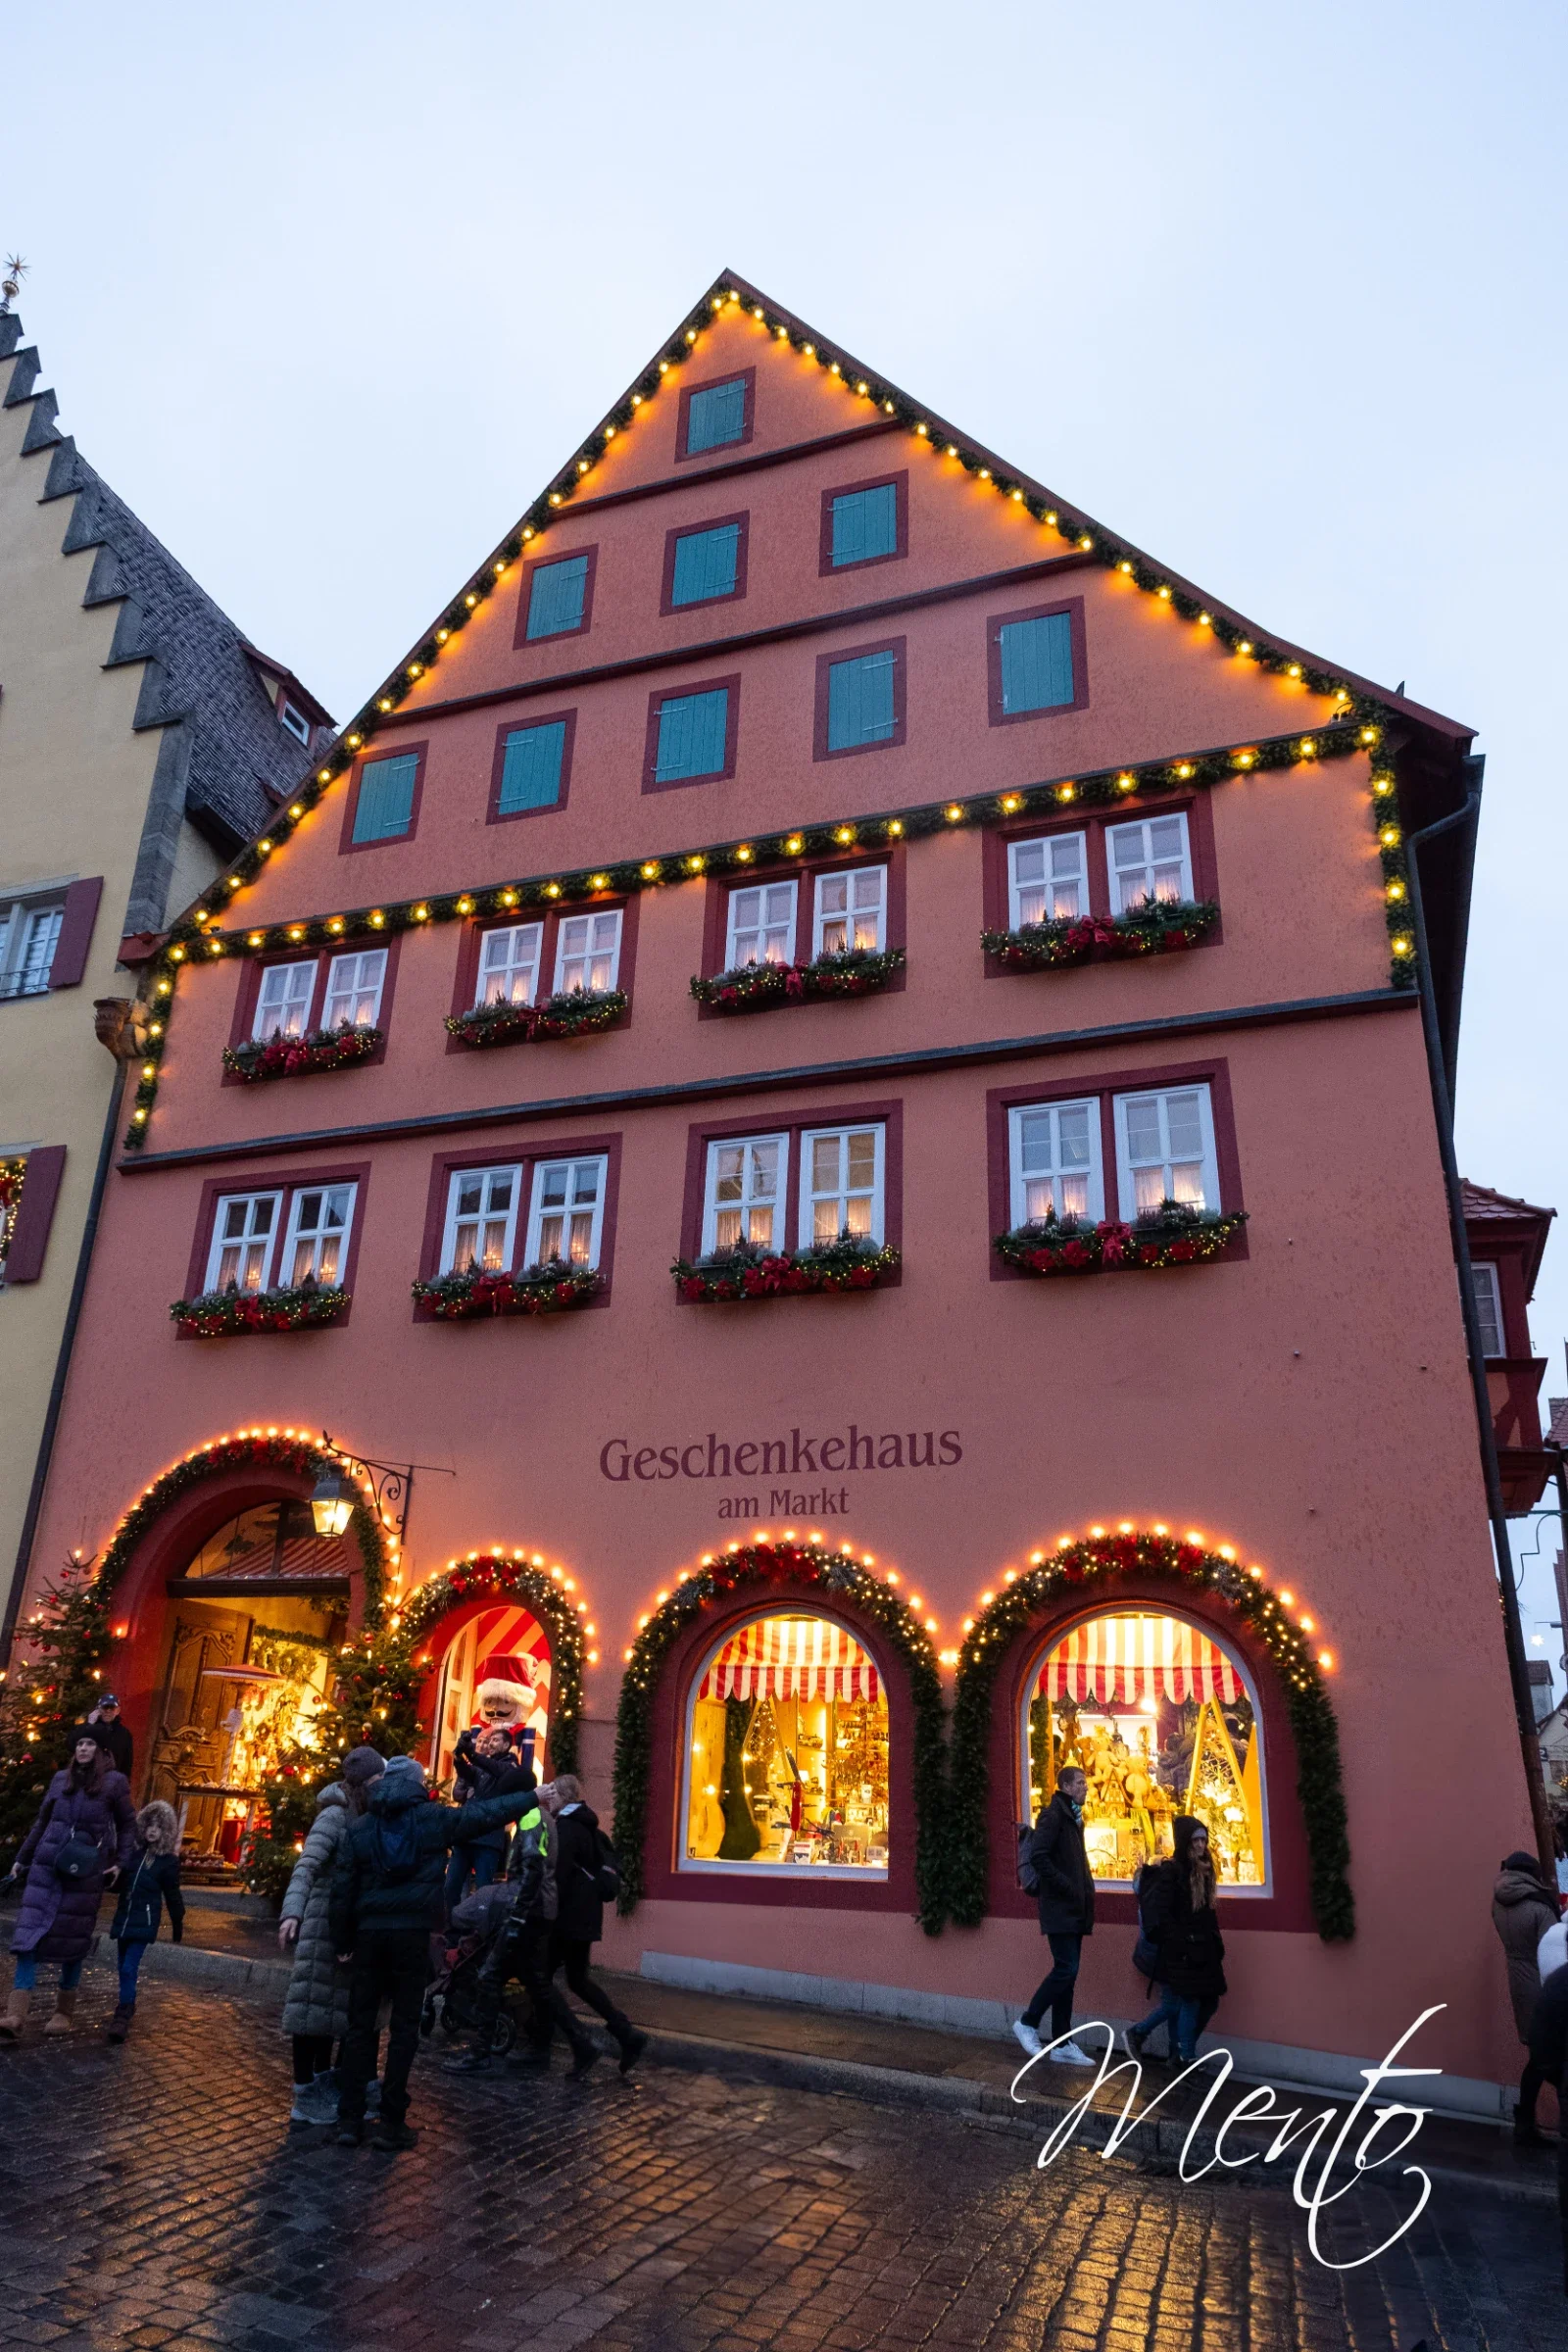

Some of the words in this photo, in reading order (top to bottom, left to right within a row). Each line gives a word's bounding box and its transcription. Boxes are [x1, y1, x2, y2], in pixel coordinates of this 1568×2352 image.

[600, 1425, 963, 1481] Geschenkehaus
[718, 1496, 760, 1519] am
[770, 1488, 850, 1517] Markt
